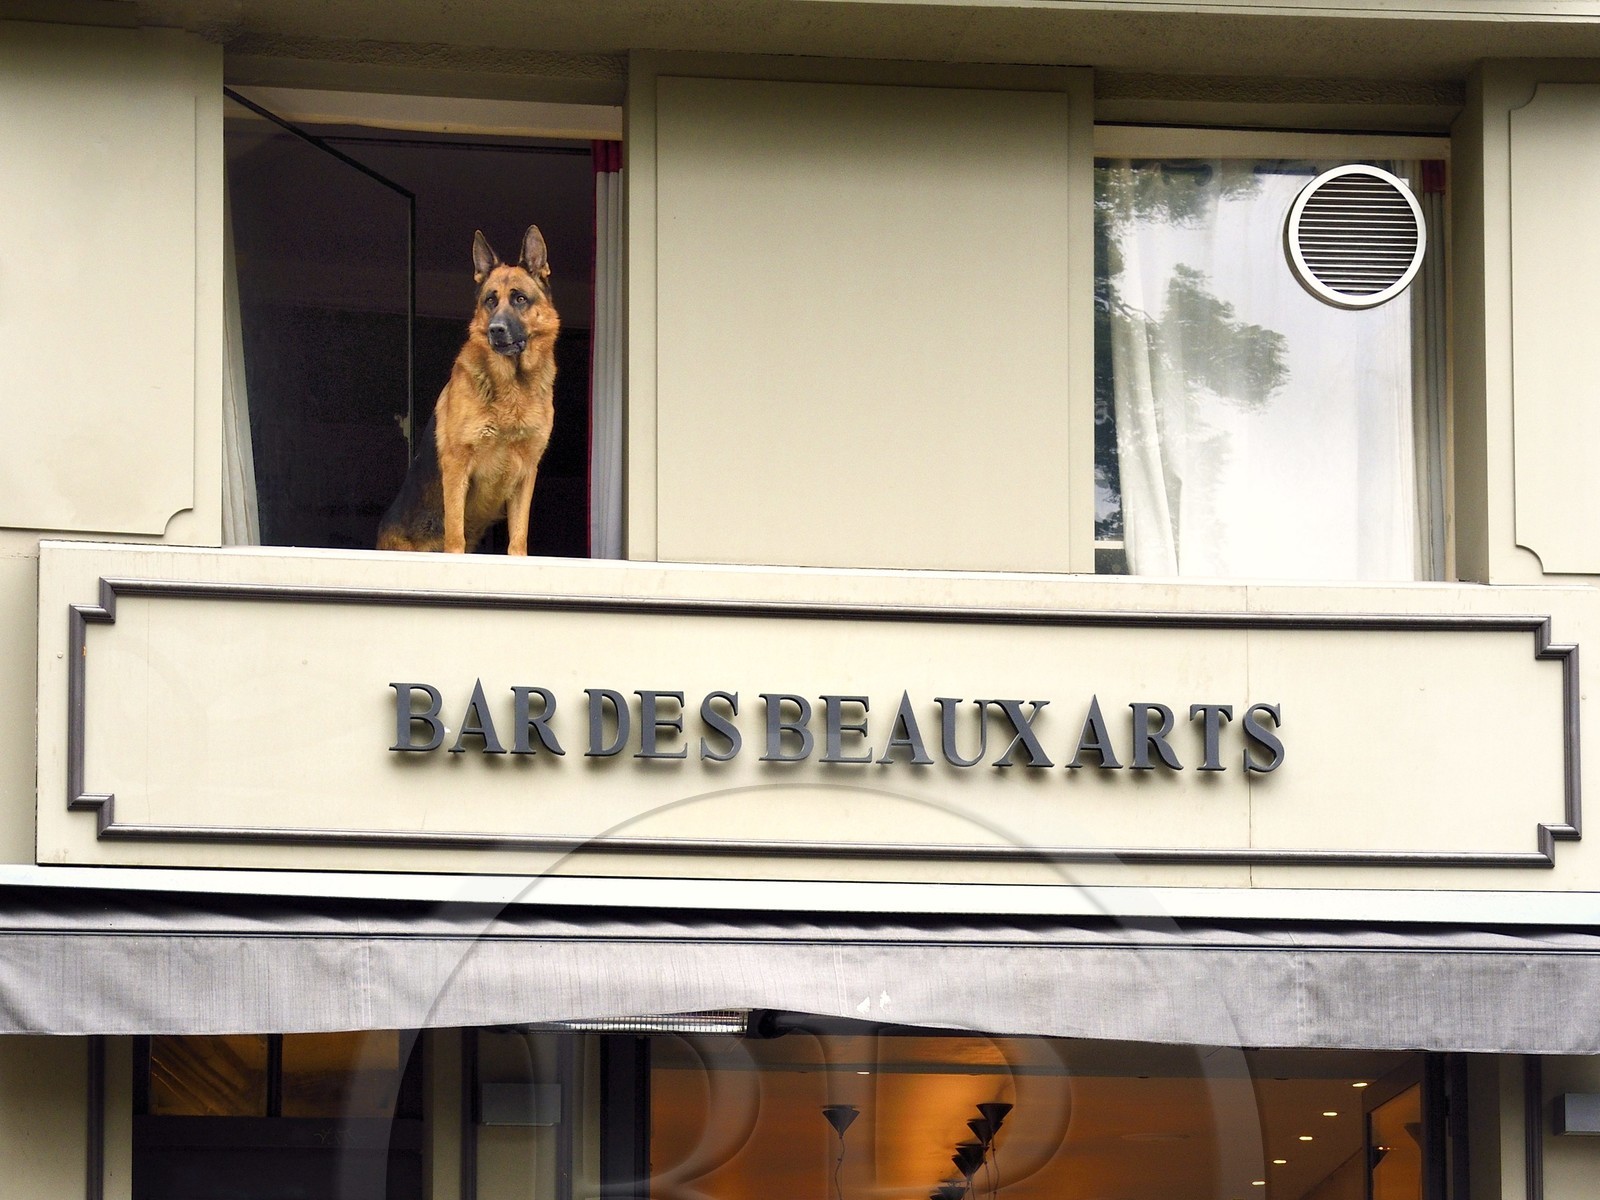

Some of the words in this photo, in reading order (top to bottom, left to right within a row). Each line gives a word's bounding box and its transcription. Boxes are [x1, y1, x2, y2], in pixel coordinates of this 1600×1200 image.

[388, 677, 566, 757] BAR
[584, 689, 743, 763] DES
[758, 689, 1055, 769] BEAUX
[1064, 693, 1286, 774] ARTS
